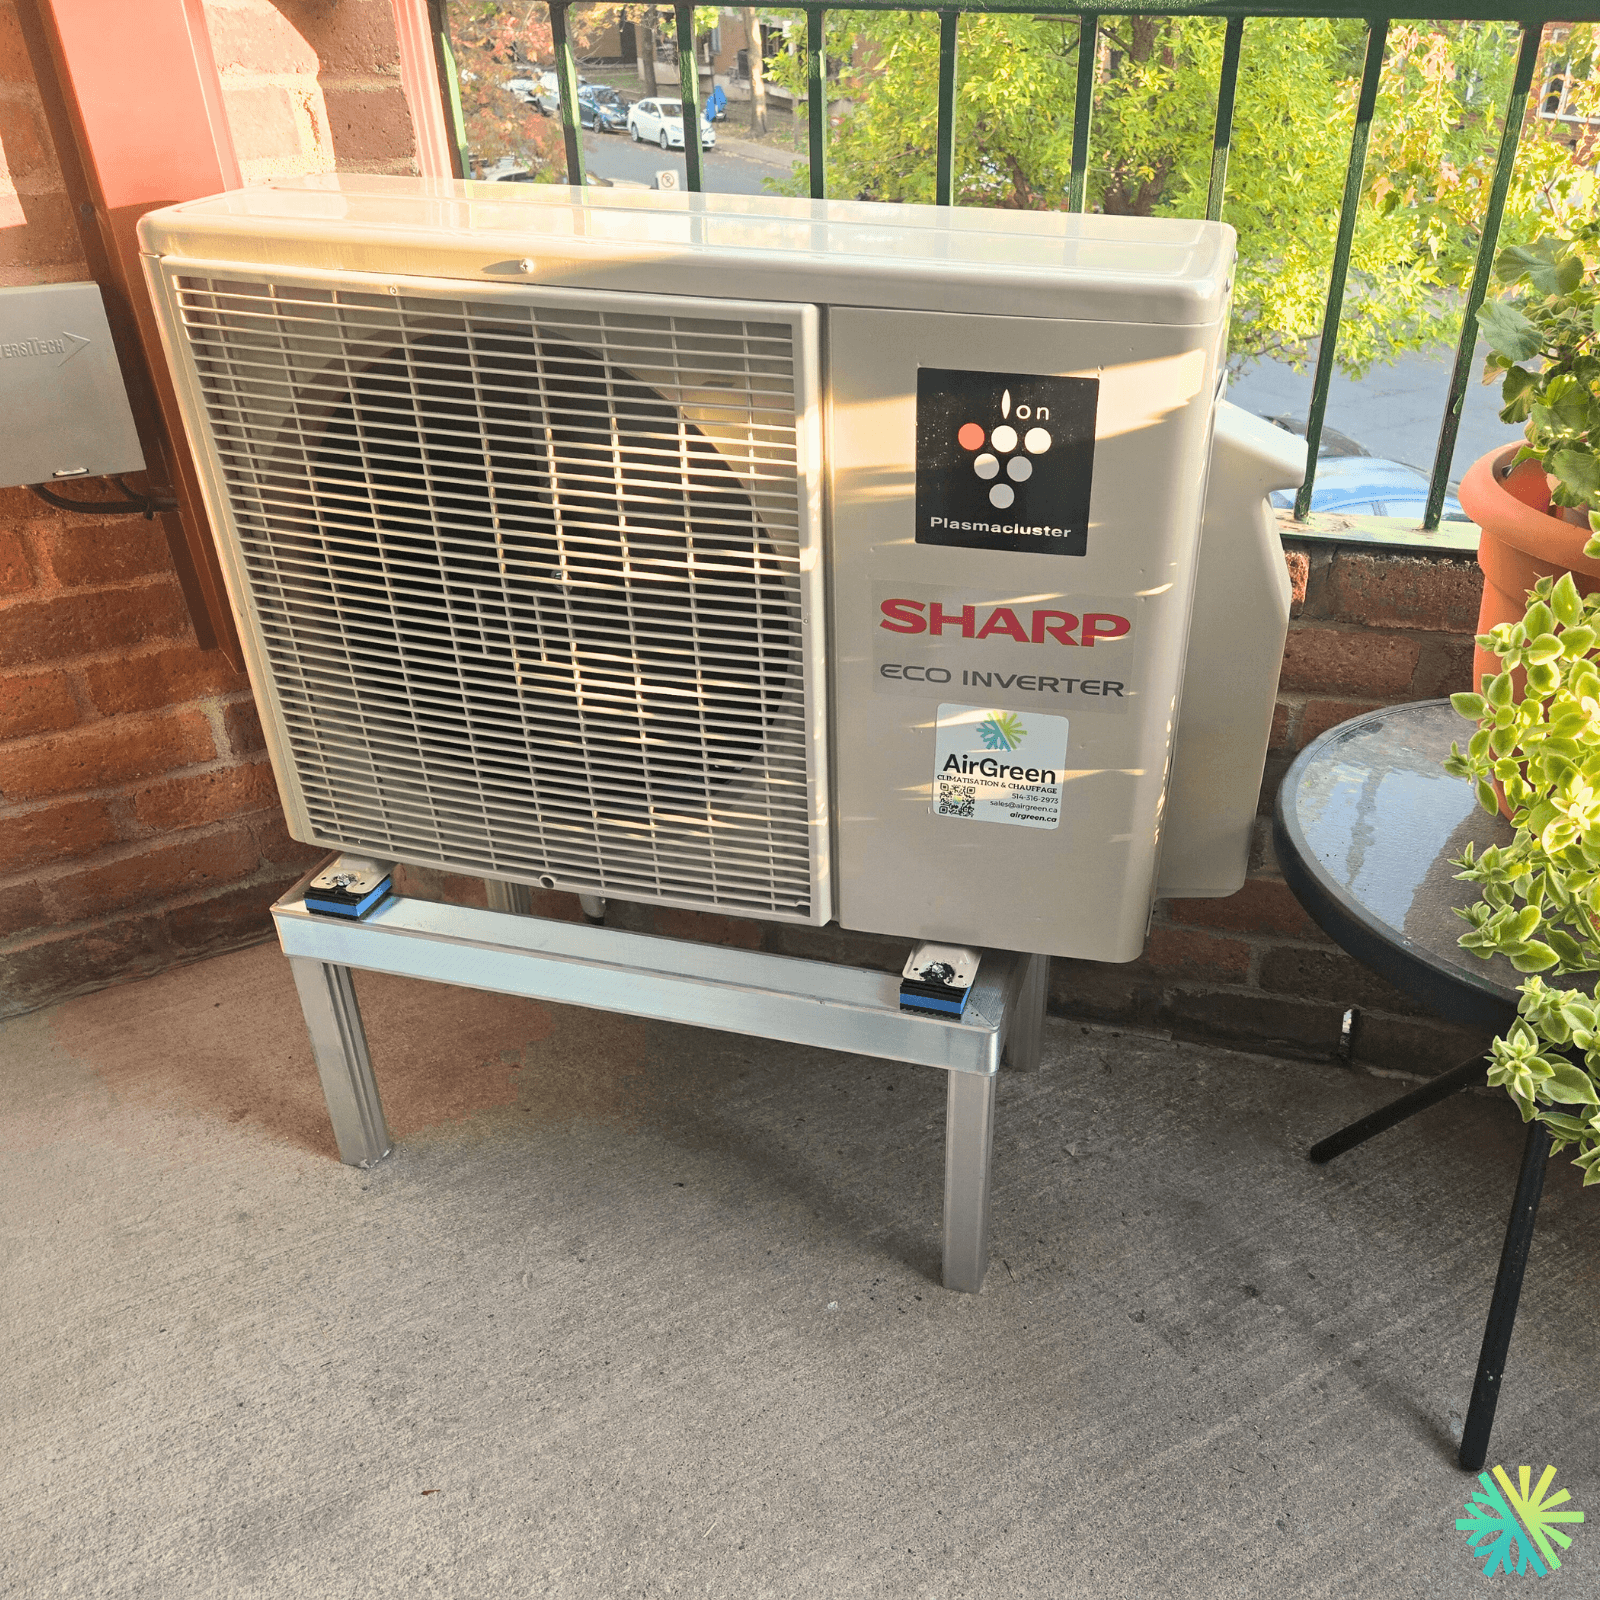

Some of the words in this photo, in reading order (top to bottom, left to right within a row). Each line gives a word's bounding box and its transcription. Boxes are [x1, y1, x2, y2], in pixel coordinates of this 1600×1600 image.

[1001, 388, 1050, 421] Ion
[930, 516, 1072, 538] Plasmacluster
[879, 598, 1131, 647] SHARP
[880, 663, 951, 684] ECO
[962, 670, 1124, 698] INVERTER
[943, 754, 1056, 784] AirGreen
[937, 775, 999, 787] CLIMATISATION
[1008, 783, 1057, 794] CHAUFFAGE
[990, 801, 1058, 813] sales@airgreen.ca
[1012, 793, 1058, 804] 514-316-2973
[1010, 812, 1057, 822] airgreen.ca
